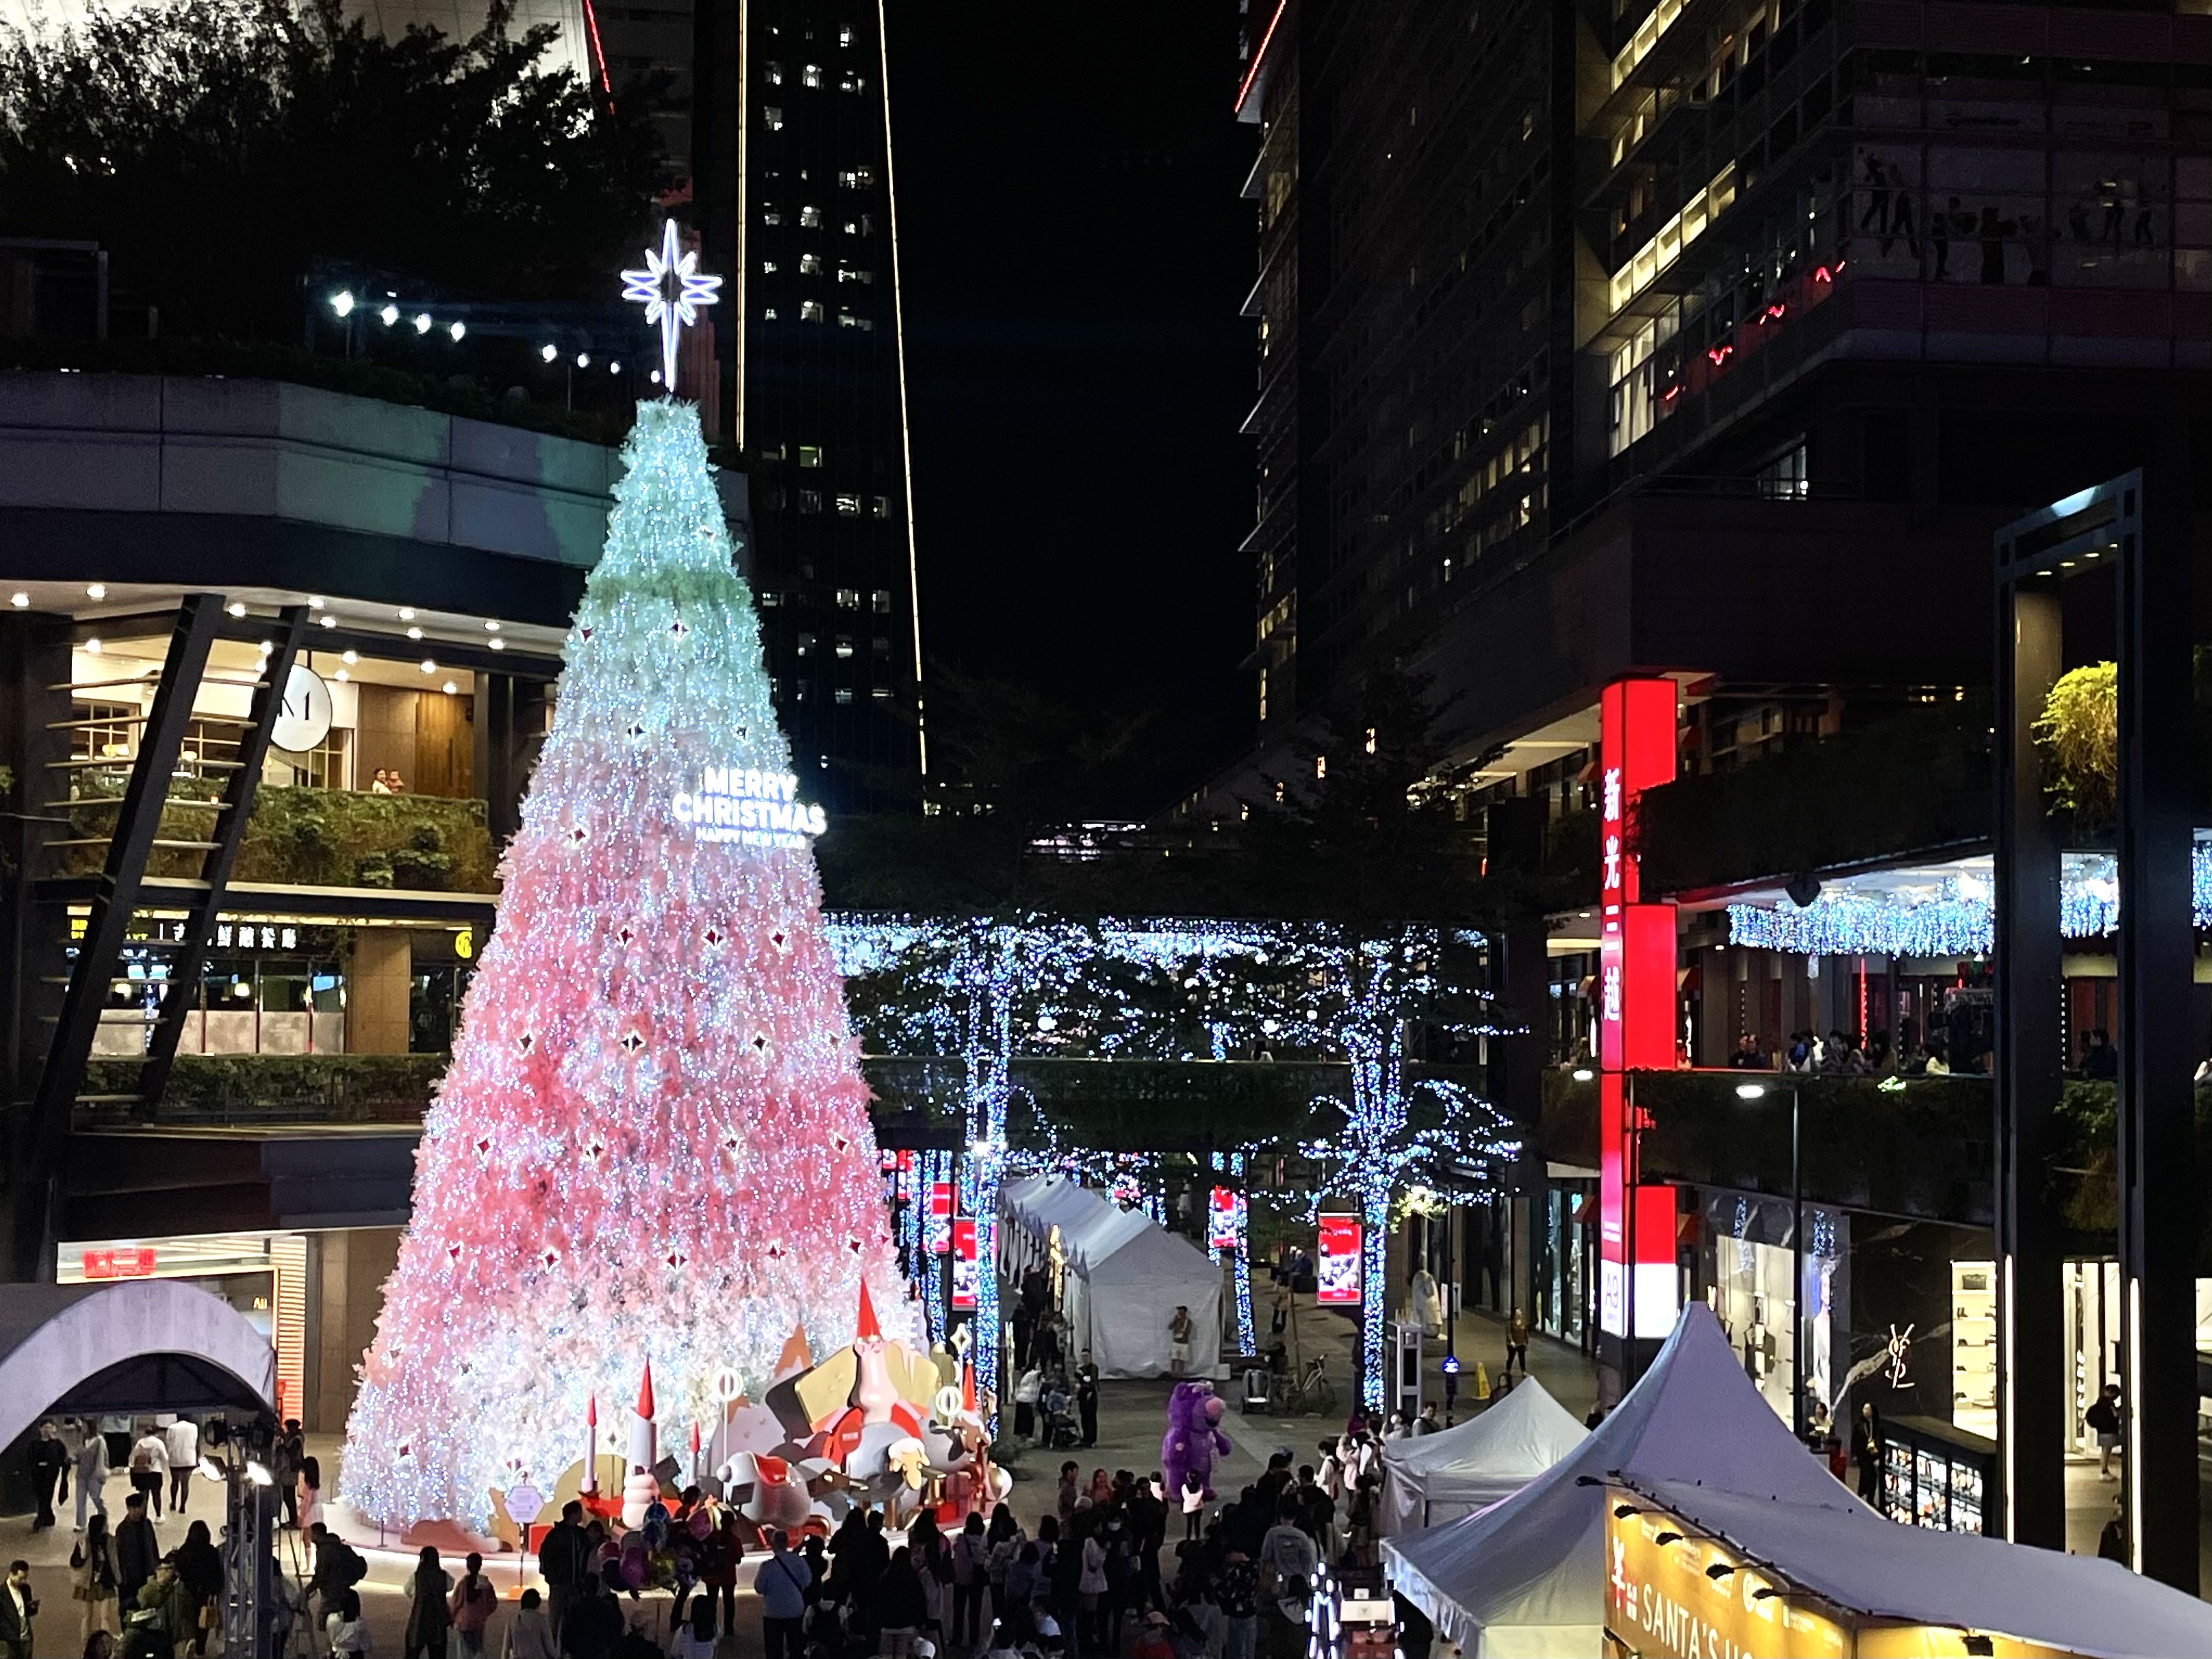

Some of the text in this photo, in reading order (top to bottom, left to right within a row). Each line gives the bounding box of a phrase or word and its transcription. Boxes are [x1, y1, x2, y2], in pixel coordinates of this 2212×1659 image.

[703, 766, 798, 801] MERRY
[672, 792, 827, 834] CHRISTMAS
[695, 826, 806, 849] HAPPY NEW YEAR
[1603, 768, 1620, 1022] 新光三越
[1605, 1273, 1619, 1309] A9
[1642, 1582, 1719, 1659] SANTA'S
